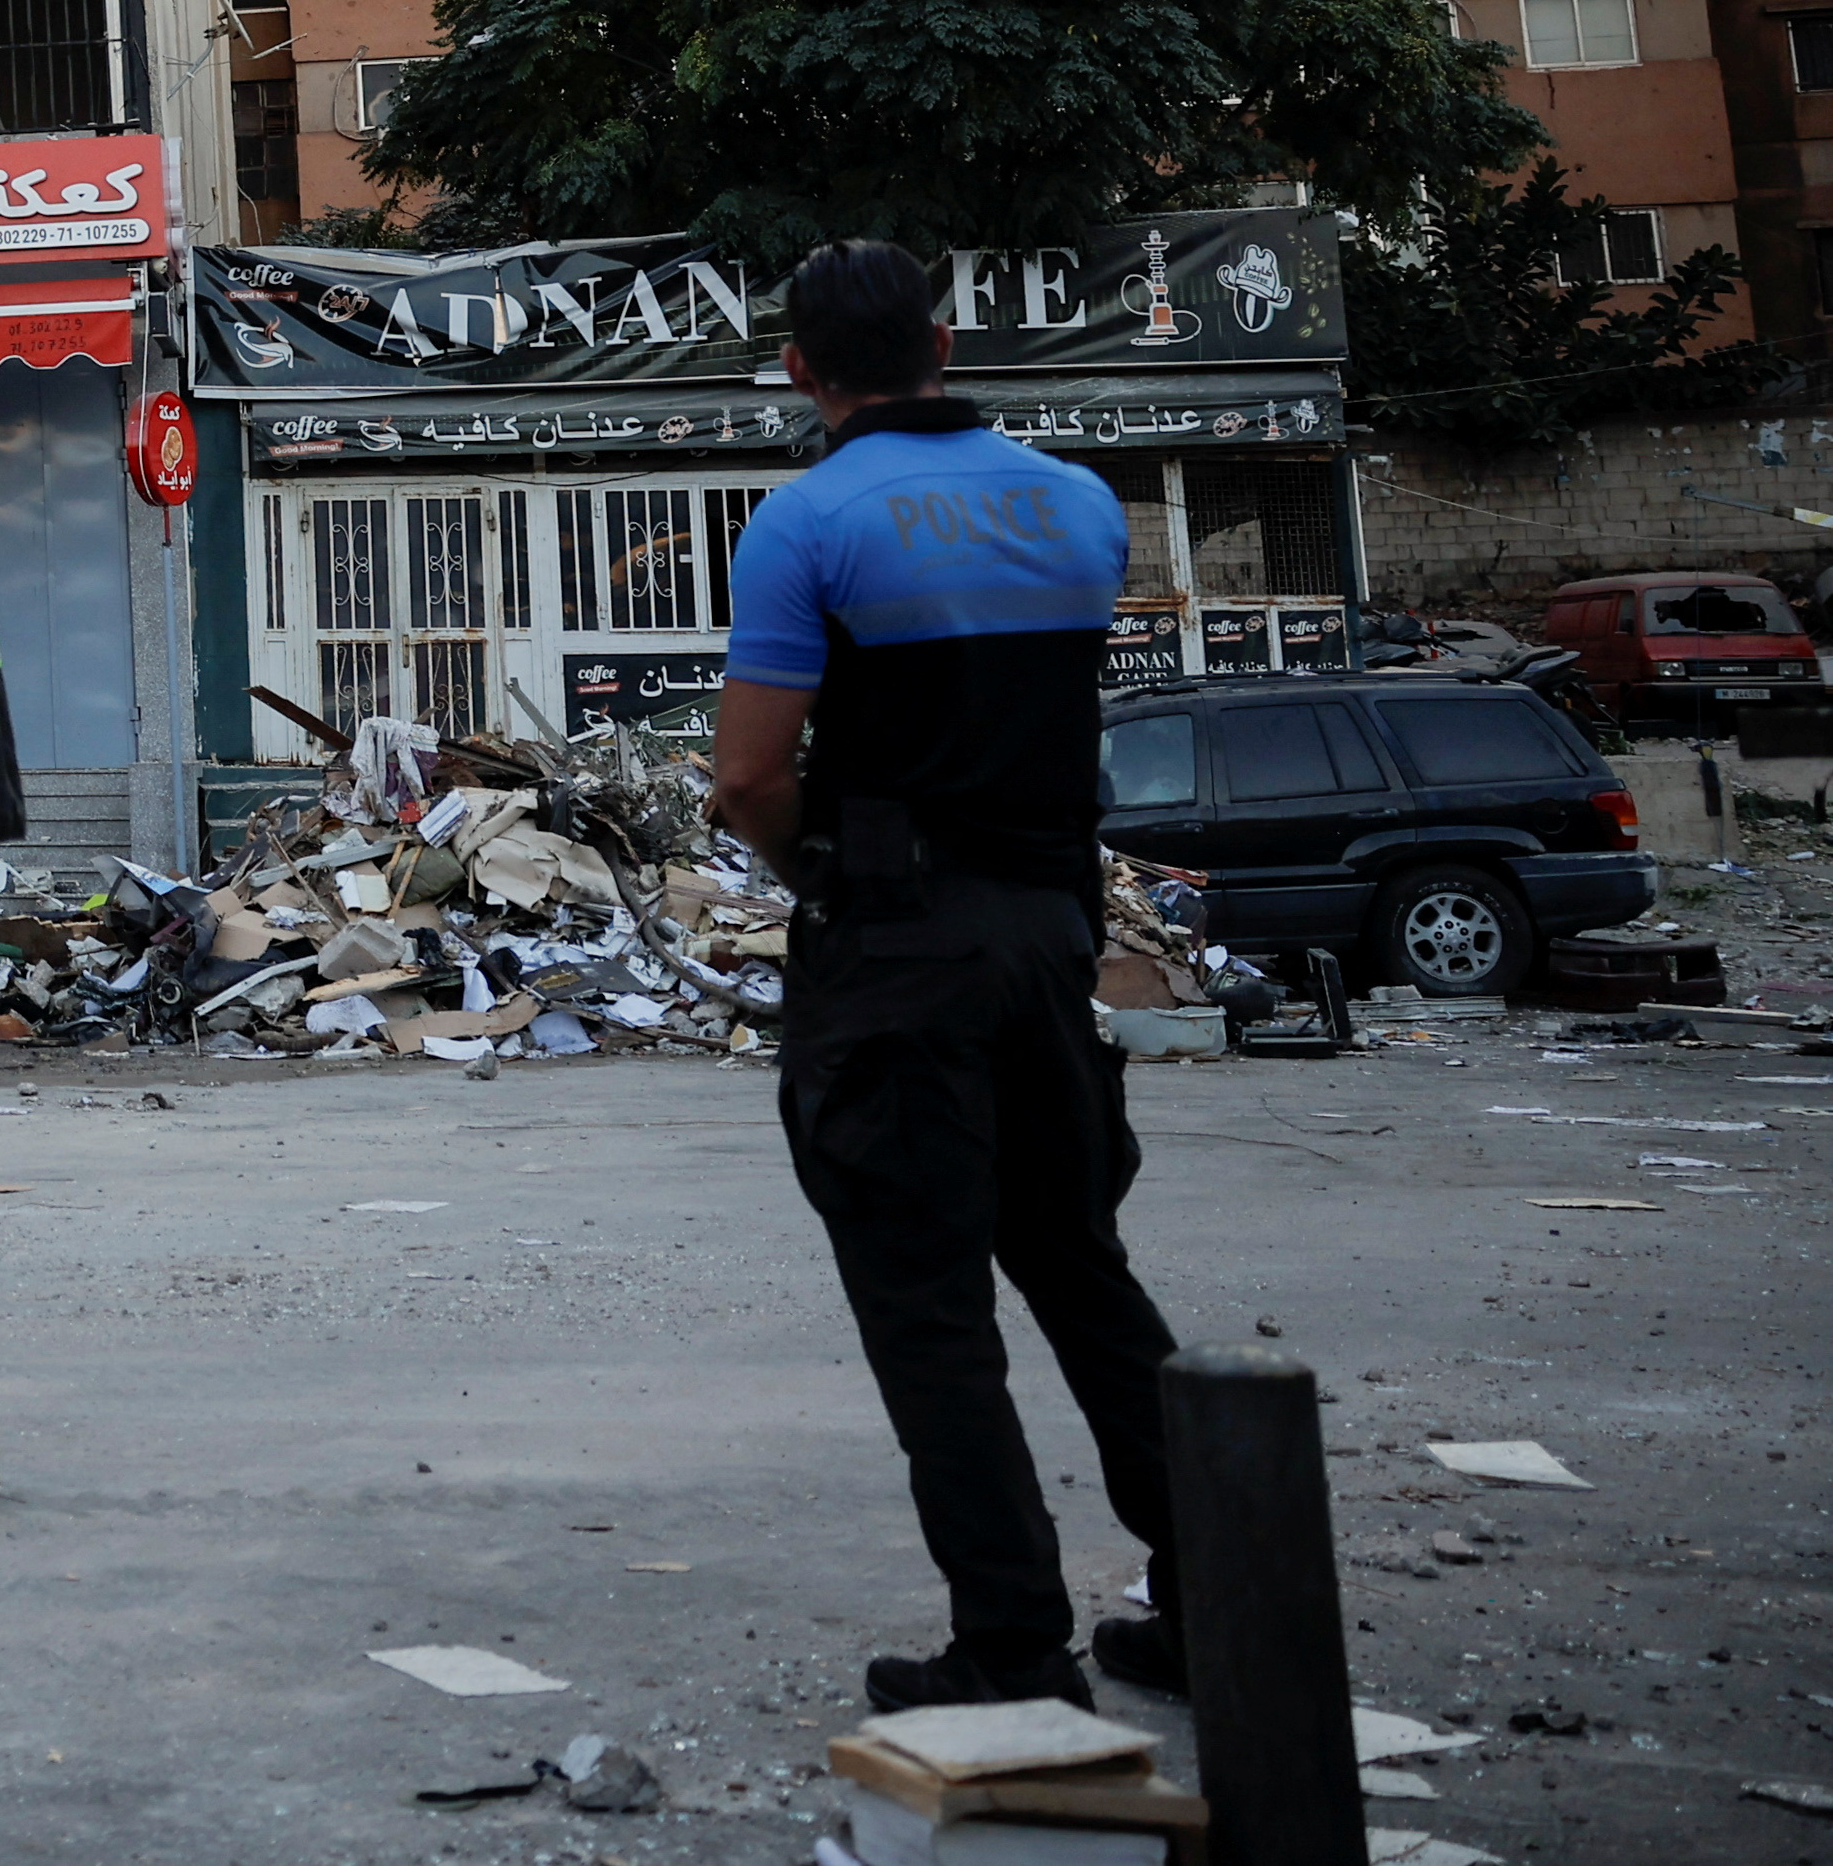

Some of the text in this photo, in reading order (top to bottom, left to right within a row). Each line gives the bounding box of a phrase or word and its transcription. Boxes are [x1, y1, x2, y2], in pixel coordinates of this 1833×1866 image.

[228, 263, 295, 288] coffee
[229, 291, 254, 300] Good
[329, 295, 370, 312] 24/7
[371, 259, 754, 360] ADNAN
[158, 404, 181, 421] كعكة
[272, 415, 338, 441] coffee
[422, 411, 645, 452] عدنان كافيه
[991, 402, 1202, 446] عدنان كافيه
[274, 442, 339, 455] Good Morning!
[179, 465, 193, 491] أبو
[886, 485, 1070, 551] POLICE
[1207, 619, 1242, 635] coffee
[1284, 620, 1319, 635] coffee
[1106, 652, 1176, 670] ADNAN
[577, 664, 618, 683] coffee
